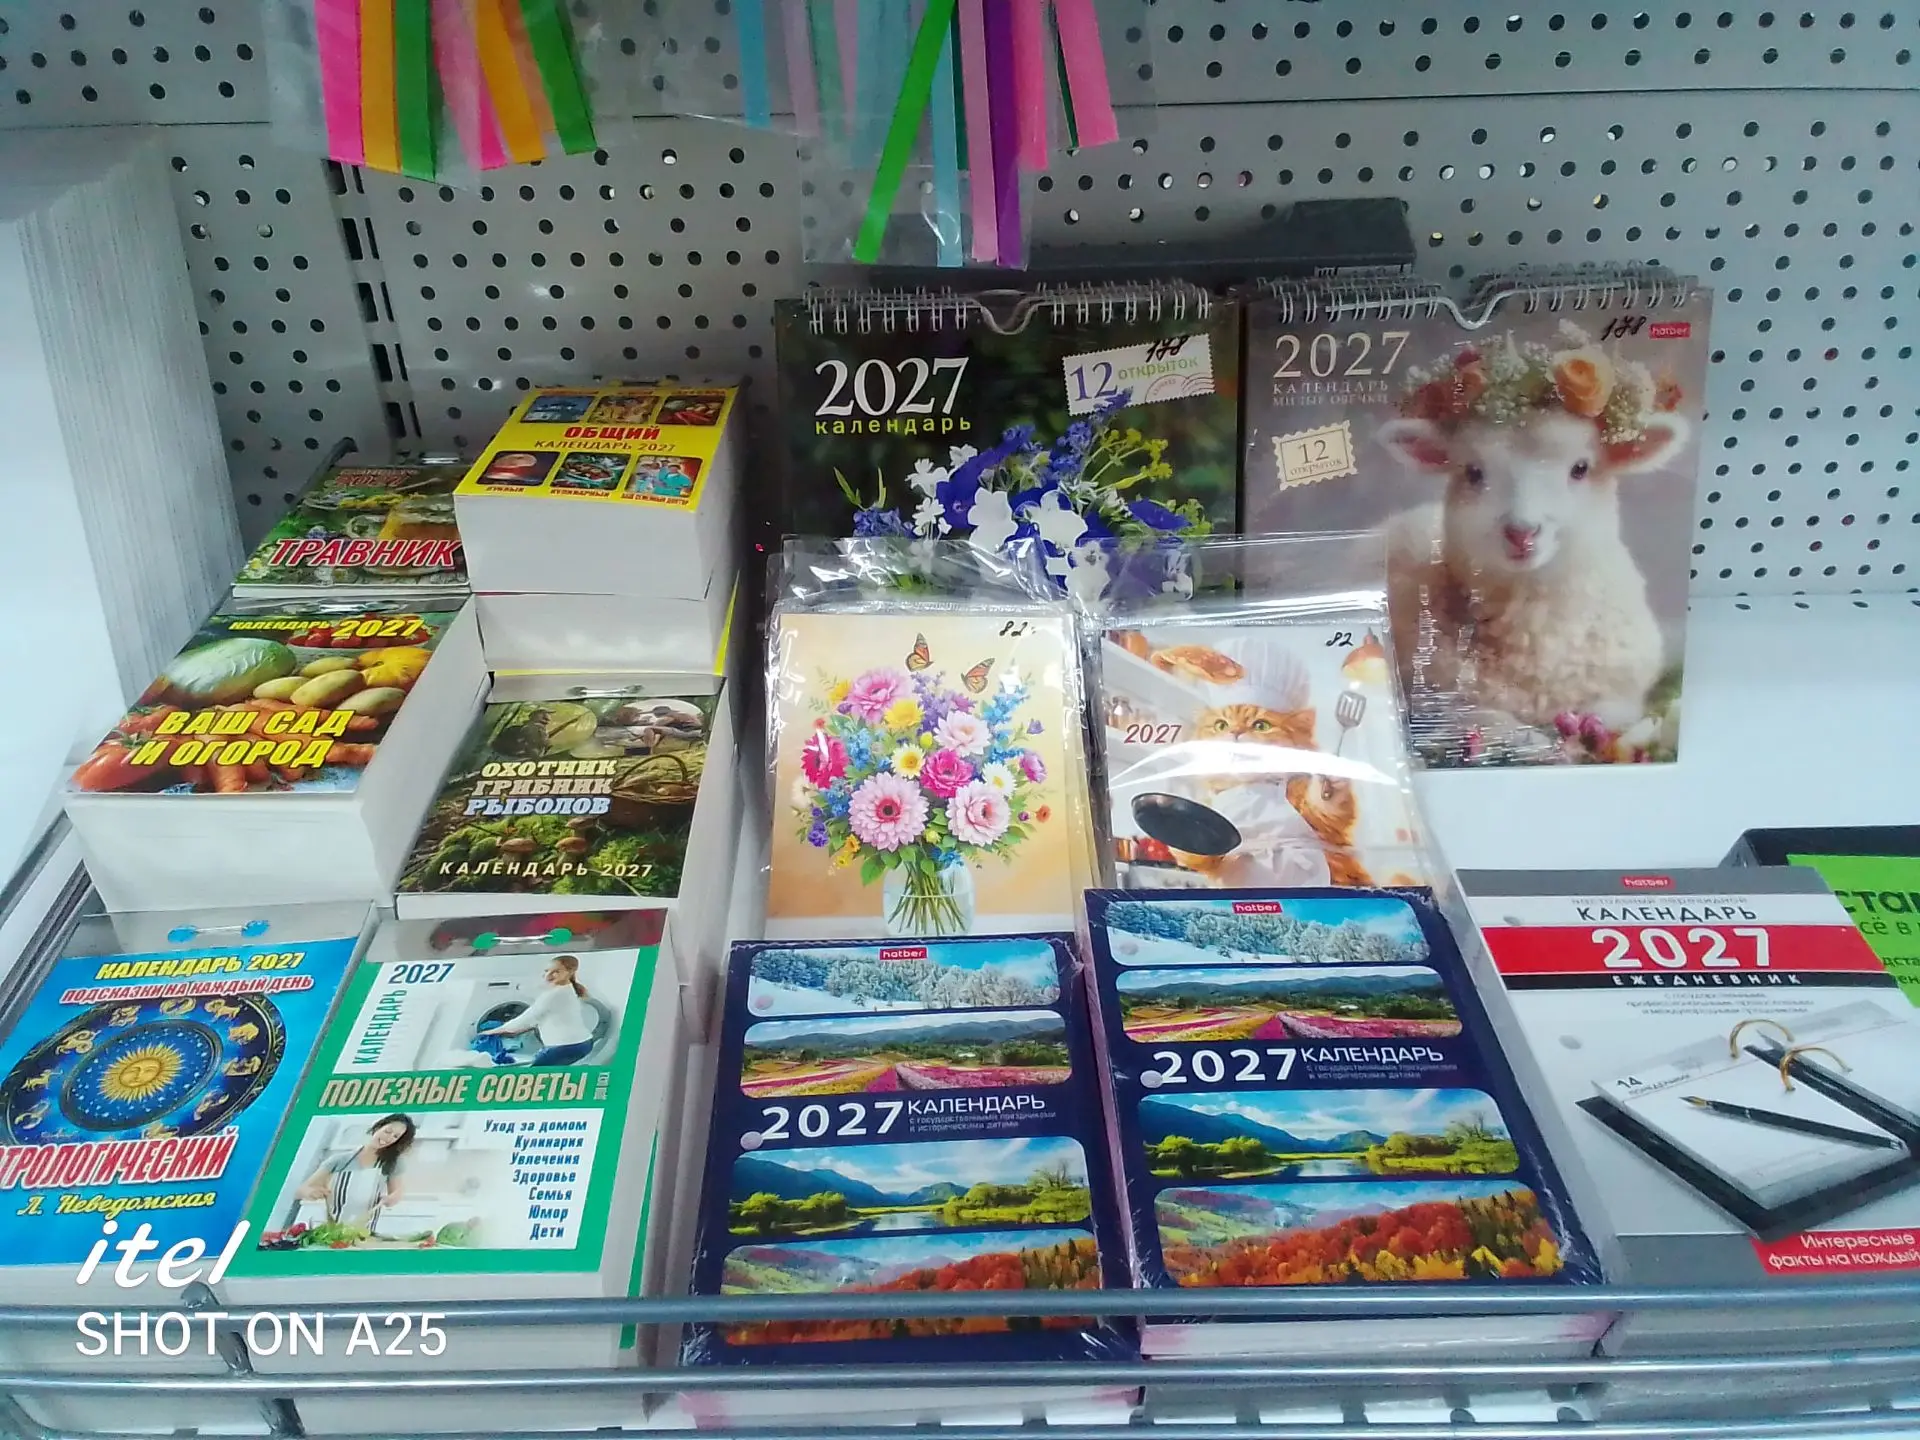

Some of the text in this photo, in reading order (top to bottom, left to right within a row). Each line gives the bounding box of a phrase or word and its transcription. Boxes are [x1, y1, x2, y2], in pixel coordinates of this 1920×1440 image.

[1273, 330, 1412, 380] 2027
[815, 356, 970, 417] 2027
[1069, 361, 1119, 402] 12
[1117, 357, 1199, 380] открыток
[564, 425, 661, 440] ОБЩИЙ
[815, 415, 972, 436] календарь
[534, 440, 676, 452] КАЛЕНДАРЬ 2027
[1297, 440, 1329, 464] 12
[267, 539, 463, 567] ТРАВНИК
[229, 619, 424, 638] КАЛЕНДАРЬ 2027
[1325, 631, 1353, 647] 82
[155, 710, 355, 737] ВАШ САД
[1123, 724, 1182, 744] 2027
[130, 739, 335, 768] И ОГОРОД
[481, 759, 618, 777] ОХОТНИК
[472, 778, 613, 796] ГРИБНИК
[464, 797, 611, 816] РЫБОЛОВ
[439, 861, 653, 878] КАЛЕНДАРЬ 2027
[1236, 902, 1279, 913] hatber
[1576, 906, 1757, 923] КАЛЕНДАРЬ
[1860, 916, 1888, 935] сё
[882, 949, 925, 960] hatber
[1591, 928, 1770, 969] 2027
[95, 952, 306, 980] КАЛЕНДАРЬ 2027
[387, 963, 456, 985] 2027
[60, 975, 314, 1004] ПОДСКАЗКИ НА КАЖДЫЙ ДЕНЬ
[1612, 974, 1802, 986] ЕЖЕДНЕВНИК
[352, 988, 408, 1065] КАЛЕНДАРЬ
[1153, 1046, 1444, 1084] 2027 КАЛЕНДАРЬ
[318, 1075, 473, 1108] ПОЛЕЗНЫЕ
[476, 1071, 588, 1103] СОВЕТЫ
[1616, 1075, 1642, 1089] 14
[484, 1119, 588, 1134] Уход за домом
[760, 1094, 1046, 1140] 2027 КАЛЕНДАРЬ
[514, 1135, 584, 1151] Кулинария
[0, 1126, 239, 1189] ТРОЛОГИЧЕСКИЙ
[509, 1151, 580, 1165] Увлечения
[512, 1169, 577, 1185] Здоровье
[528, 1186, 573, 1201] Семья
[55, 1192, 216, 1220] Неведомская
[528, 1204, 569, 1223] Юмор
[529, 1223, 565, 1241] Дети
[1800, 1234, 1915, 1250] Интересные
[1768, 1249, 1920, 1269] факты на каждый
